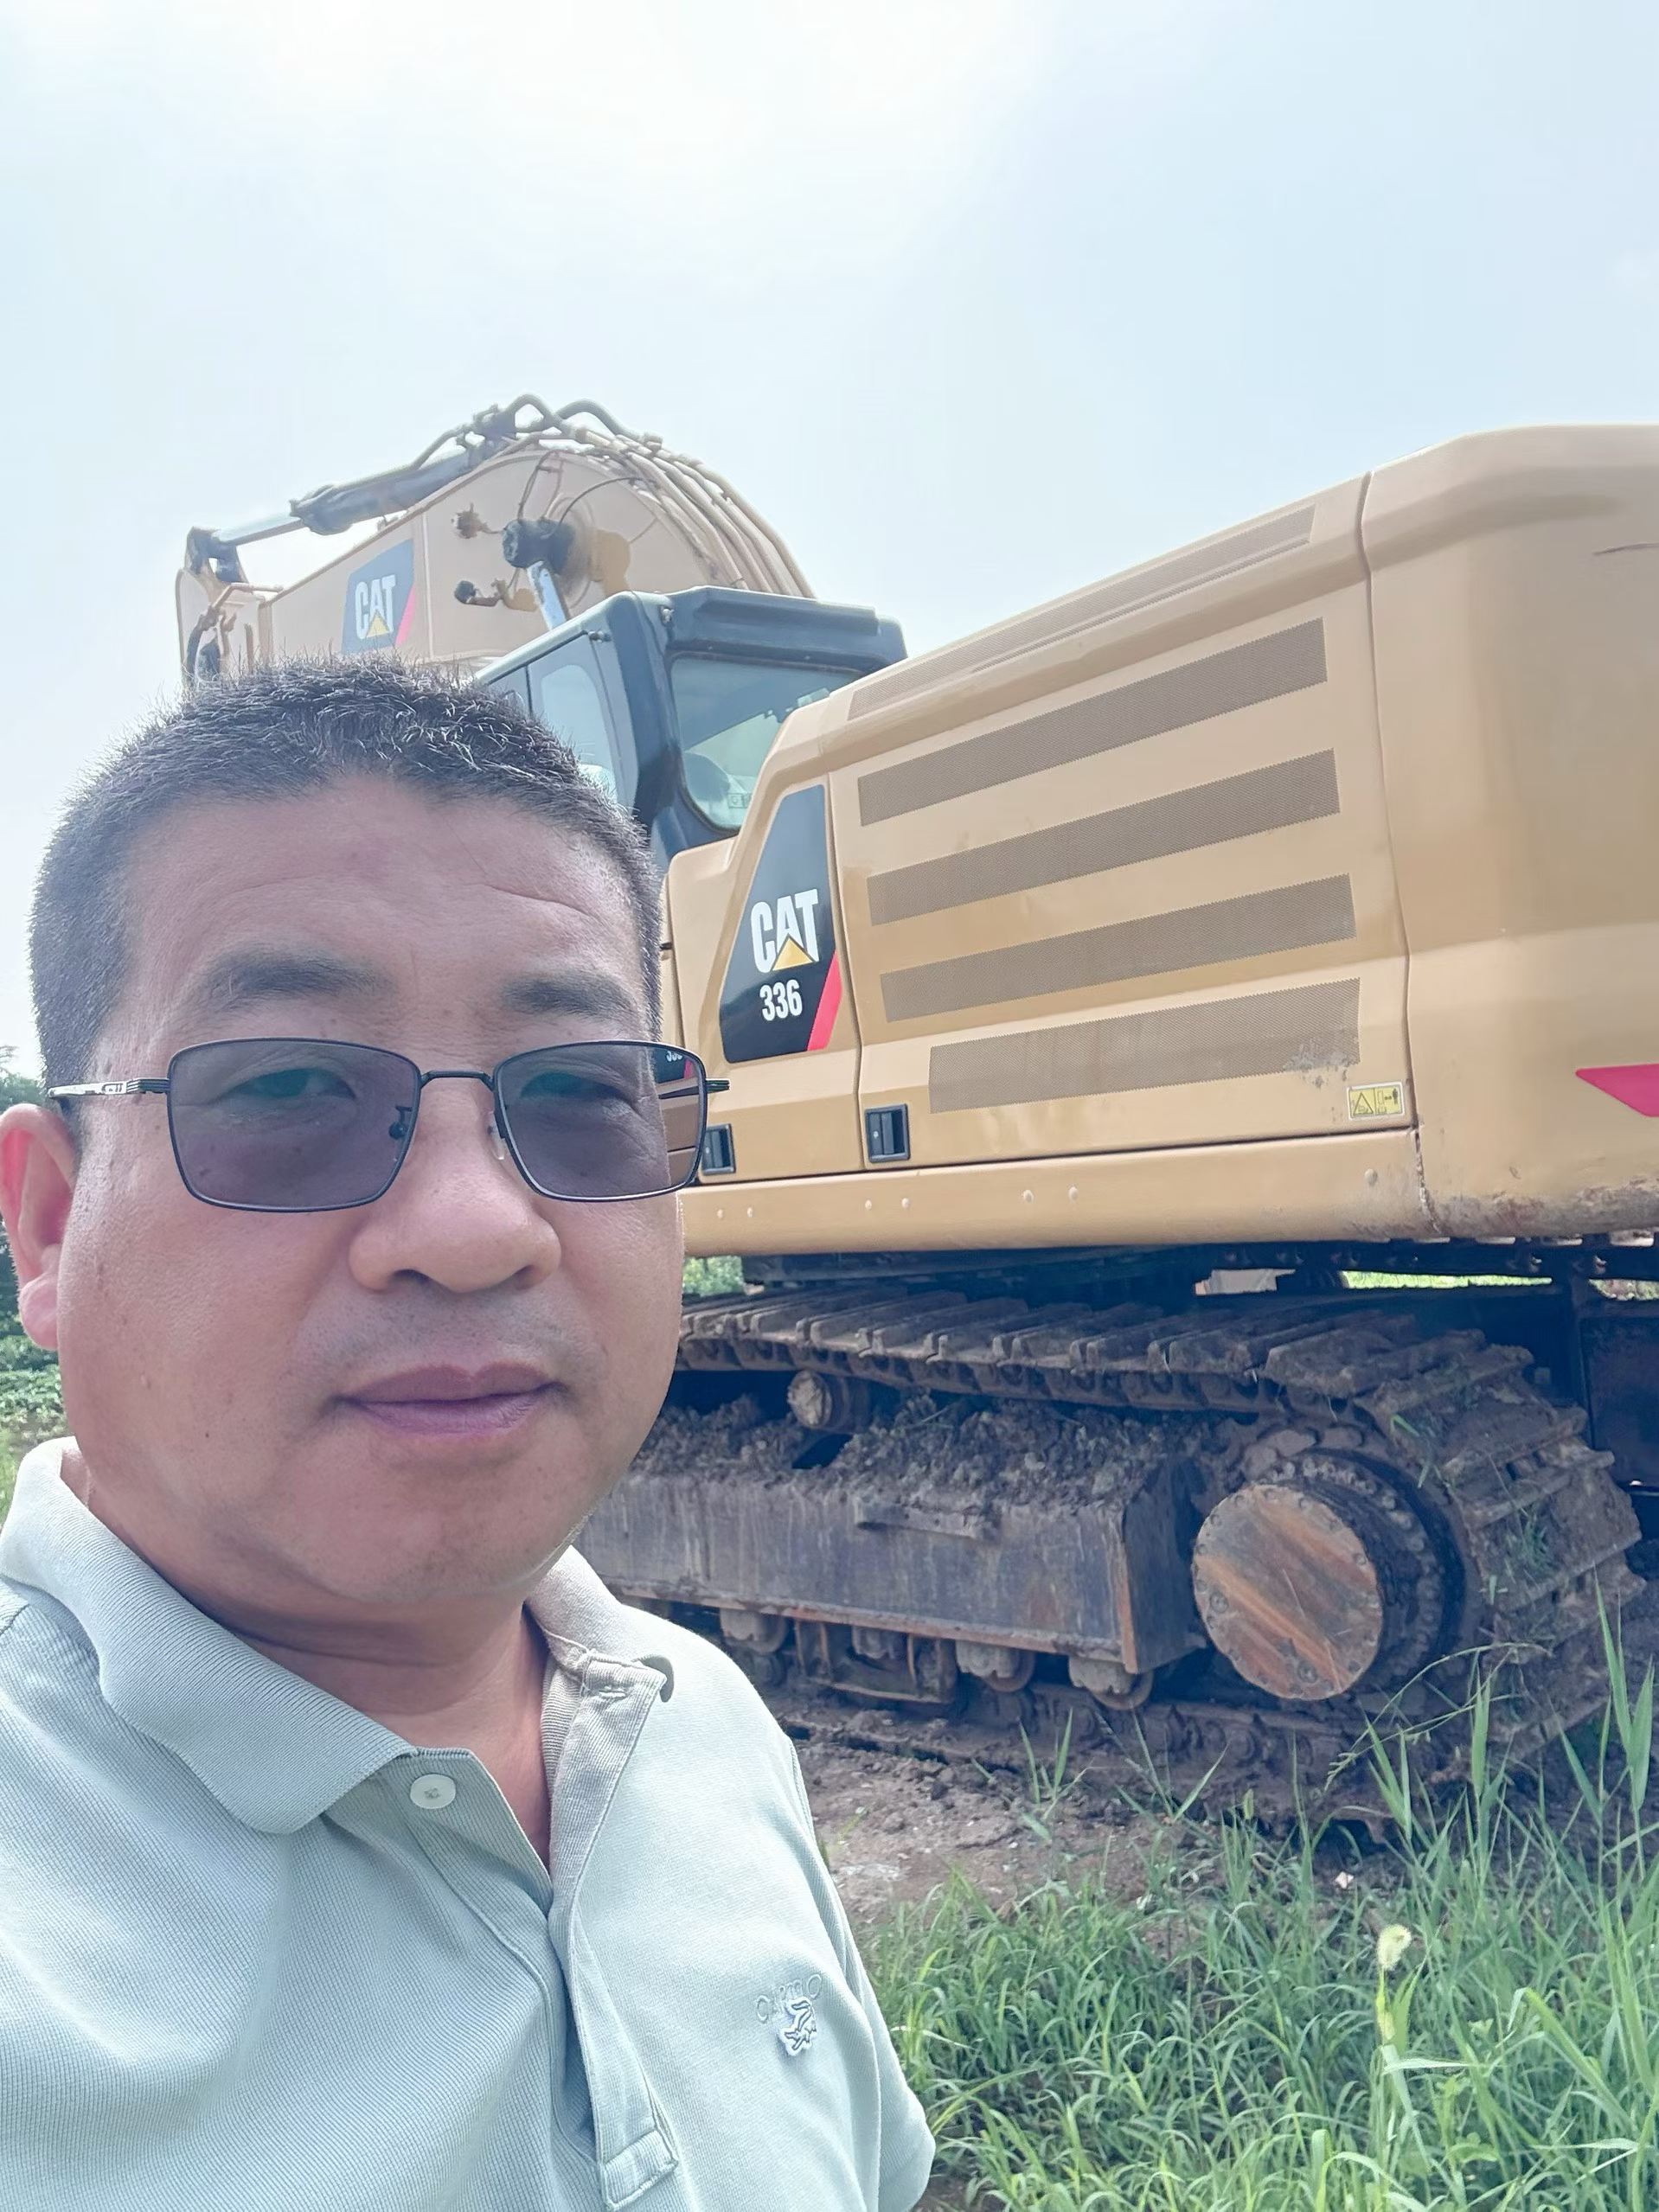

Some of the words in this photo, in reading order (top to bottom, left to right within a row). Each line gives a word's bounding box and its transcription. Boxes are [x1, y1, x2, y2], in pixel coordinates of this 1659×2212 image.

[355, 574, 396, 640] CAT
[751, 888, 820, 974] CAT
[759, 979, 803, 1021] 336
